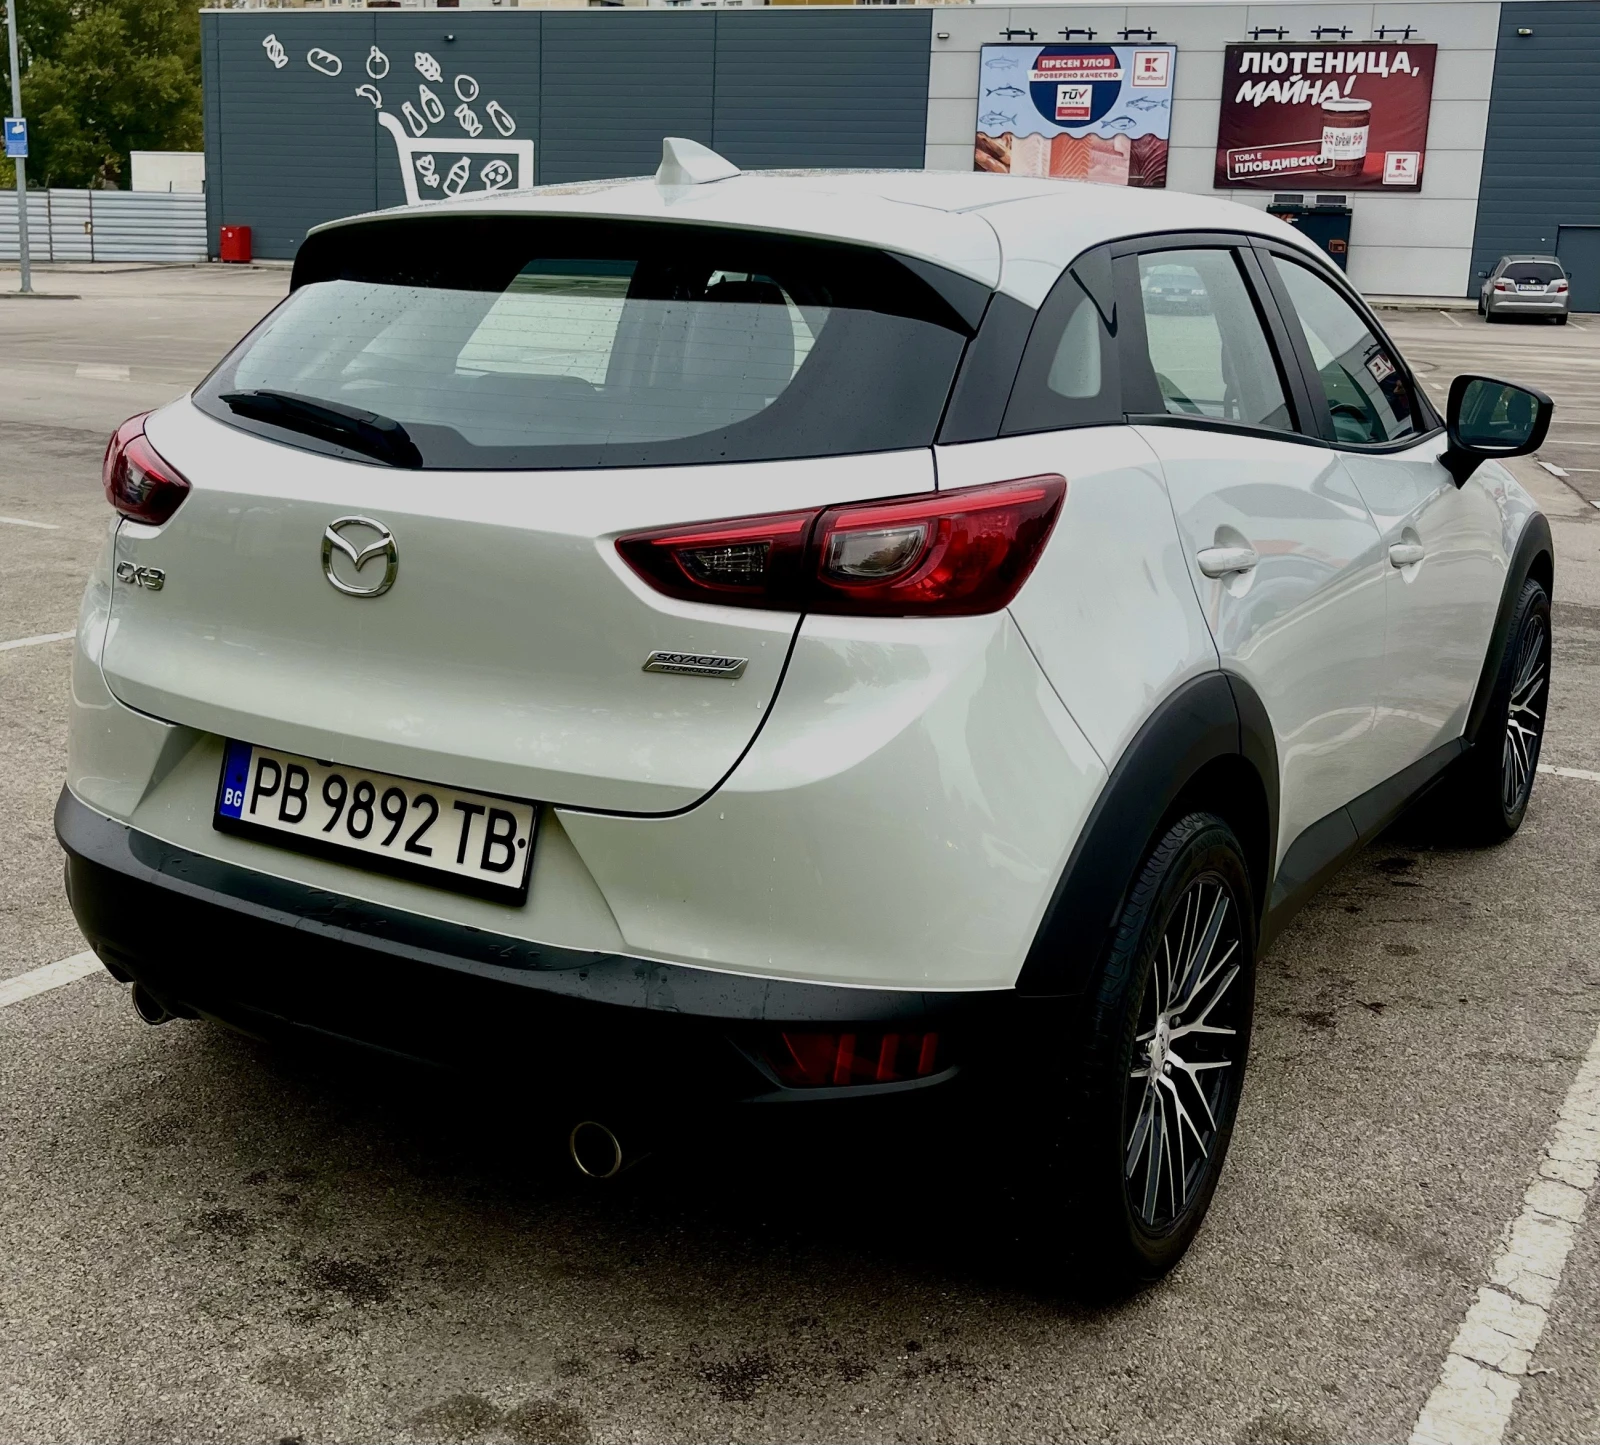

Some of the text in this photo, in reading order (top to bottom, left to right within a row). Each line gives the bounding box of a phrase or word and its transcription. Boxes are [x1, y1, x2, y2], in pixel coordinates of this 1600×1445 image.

[1041, 58, 1111, 69] ПРЕСЕН УЛОВ
[1238, 51, 1420, 78] ЛЮТЕНИЦА,
[1235, 74, 1357, 107] МАЙНА!
[1234, 153, 1255, 162] ТОВА
[1235, 154, 1328, 174] ПЛОВДИВСКО!
[655, 653, 737, 667] SKYACTIV
[661, 664, 725, 675] TECHNOLOGY
[224, 787, 243, 807] BG
[249, 757, 518, 874] PB 9892 TB
